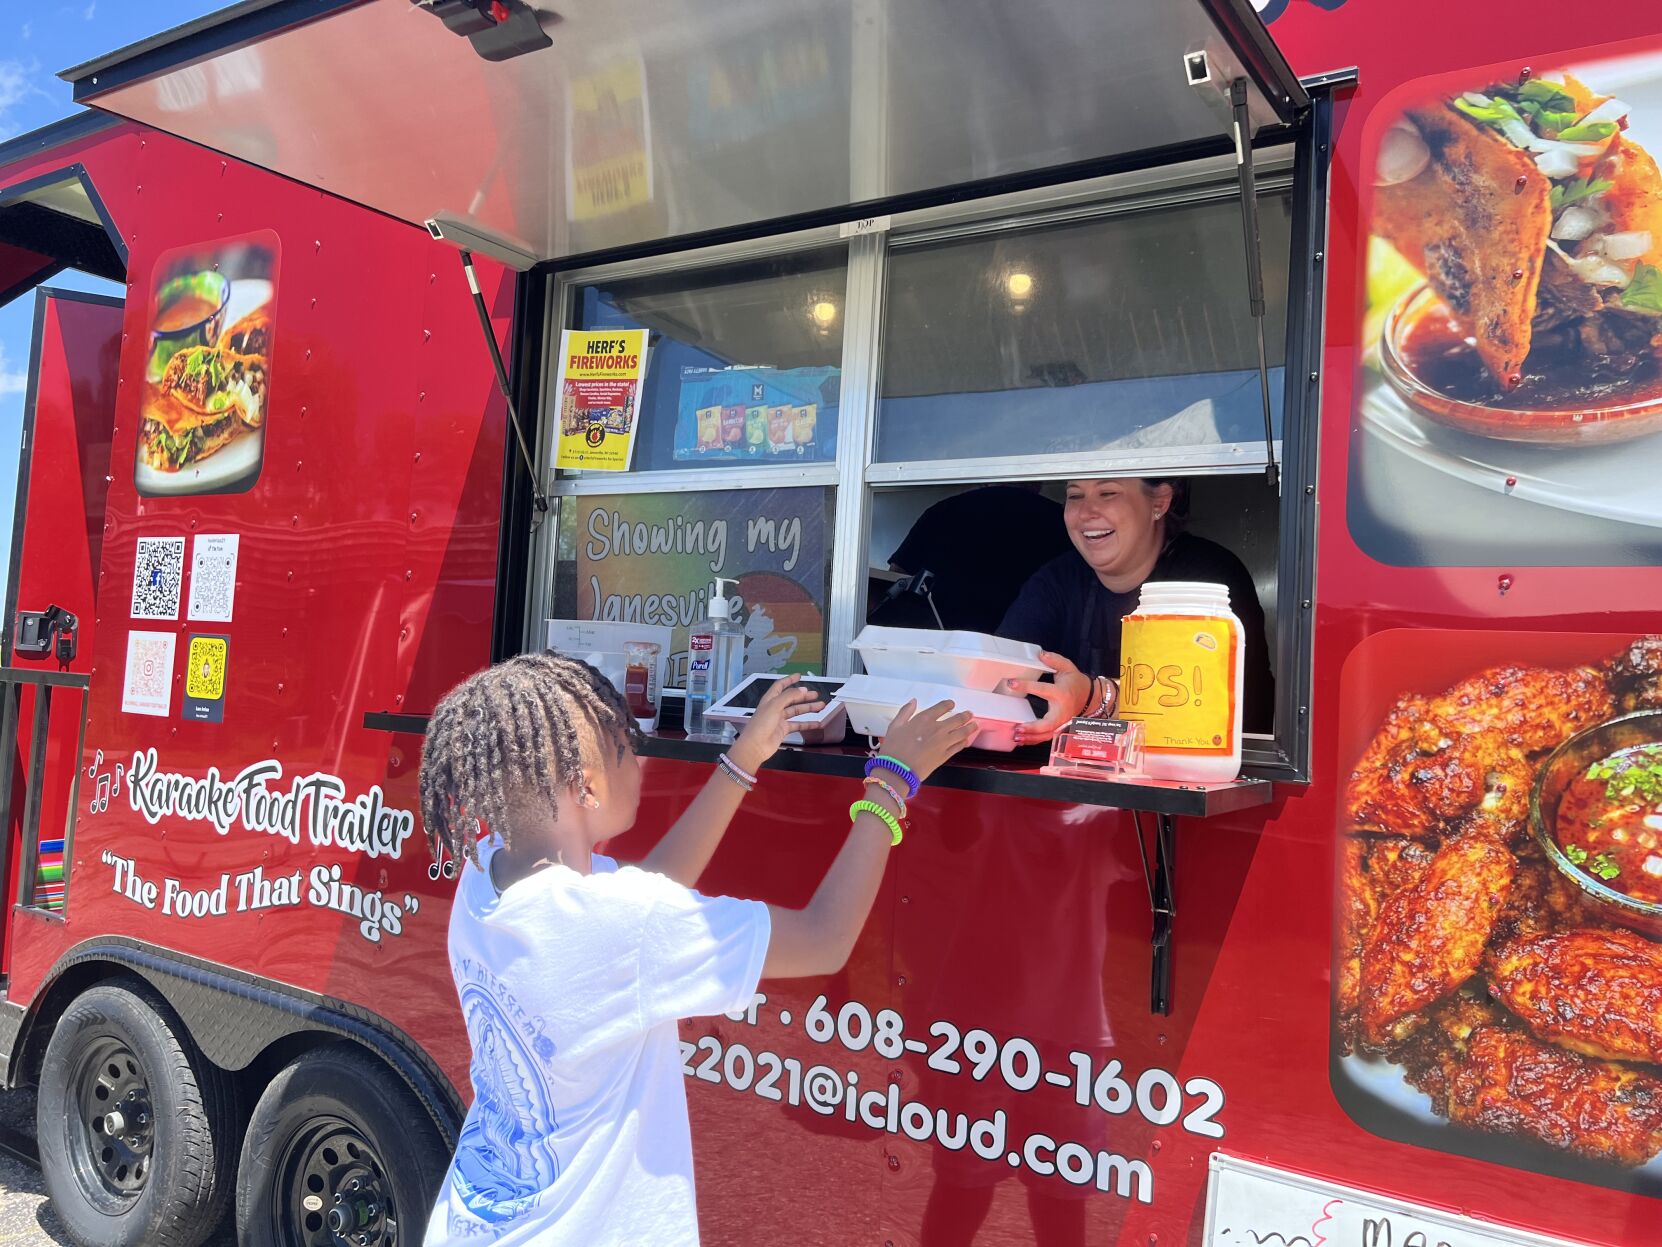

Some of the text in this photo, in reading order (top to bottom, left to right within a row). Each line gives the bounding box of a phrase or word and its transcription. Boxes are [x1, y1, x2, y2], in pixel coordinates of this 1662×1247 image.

[569, 355, 638, 370] FIREWORKS
[587, 340, 626, 354] HERF'S
[586, 507, 801, 573] Showing my
[590, 575, 744, 627] Janesvile
[1163, 736, 1211, 746] Thank You
[126, 747, 415, 860] Karaoke Food Trailer
[162, 872, 231, 919] Food
[235, 864, 302, 912] That
[804, 993, 1227, 1140] 608-290-1602
[679, 1035, 1154, 1205] z2021@icloud.com
